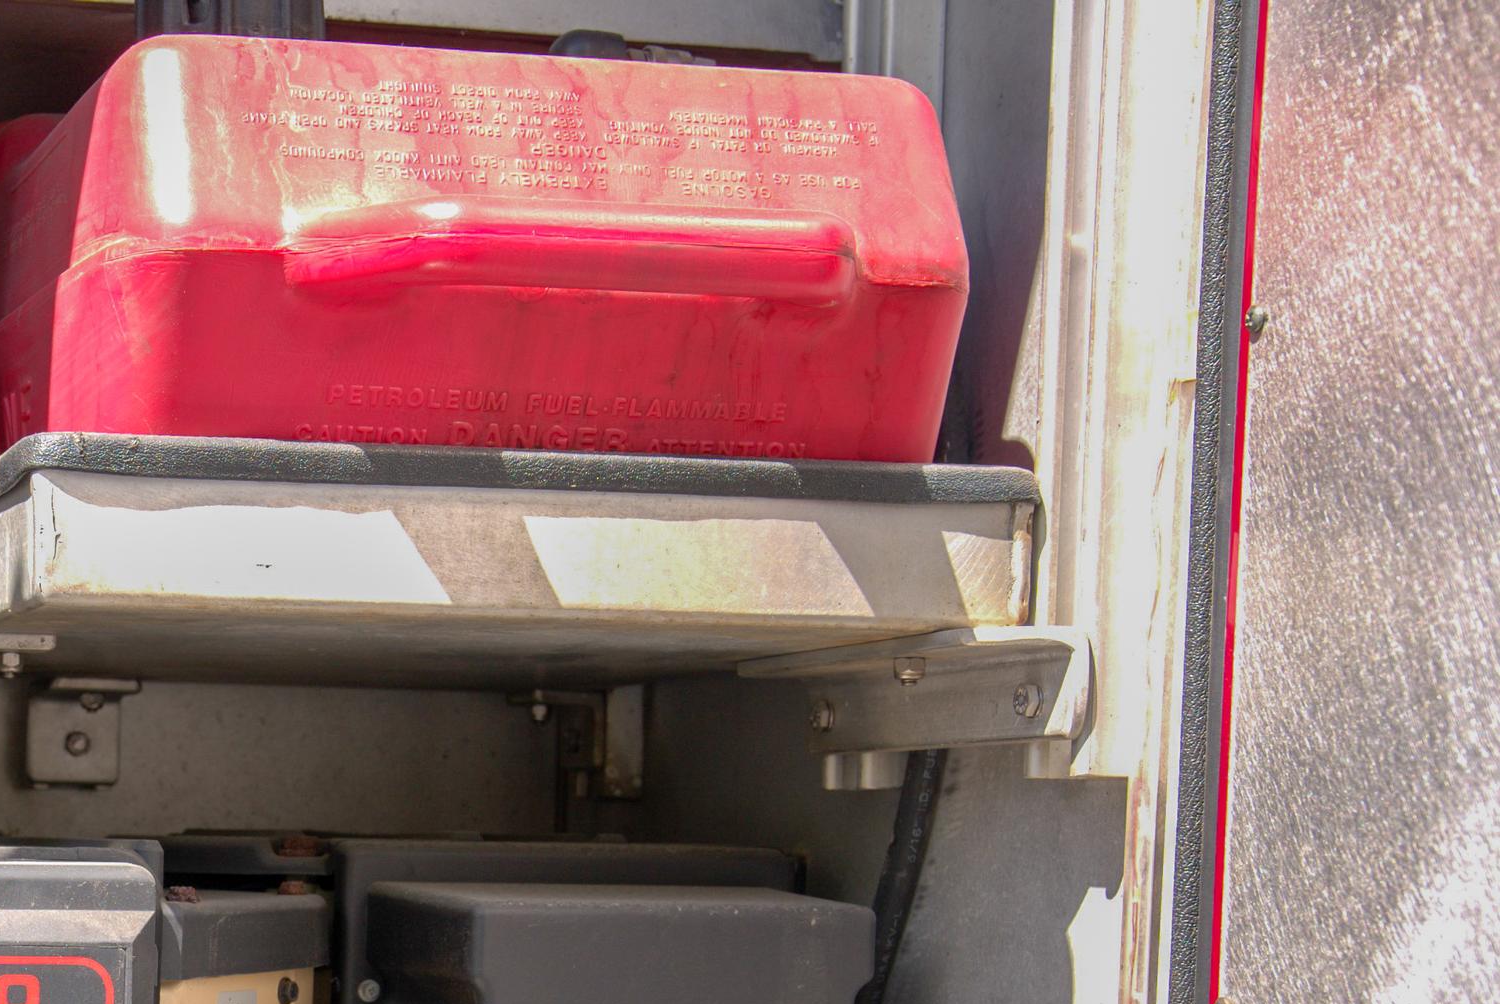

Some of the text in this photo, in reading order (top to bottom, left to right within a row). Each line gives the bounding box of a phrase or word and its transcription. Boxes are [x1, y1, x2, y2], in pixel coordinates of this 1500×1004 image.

[531, 143, 607, 161] DANGER
[374, 166, 608, 190] EXTREMELY FLAMMABLE
[682, 183, 772, 200] GASOLINE
[328, 384, 508, 412] PETROLEUM
[296, 420, 806, 459] CAUTION DANGER ATTENTION
